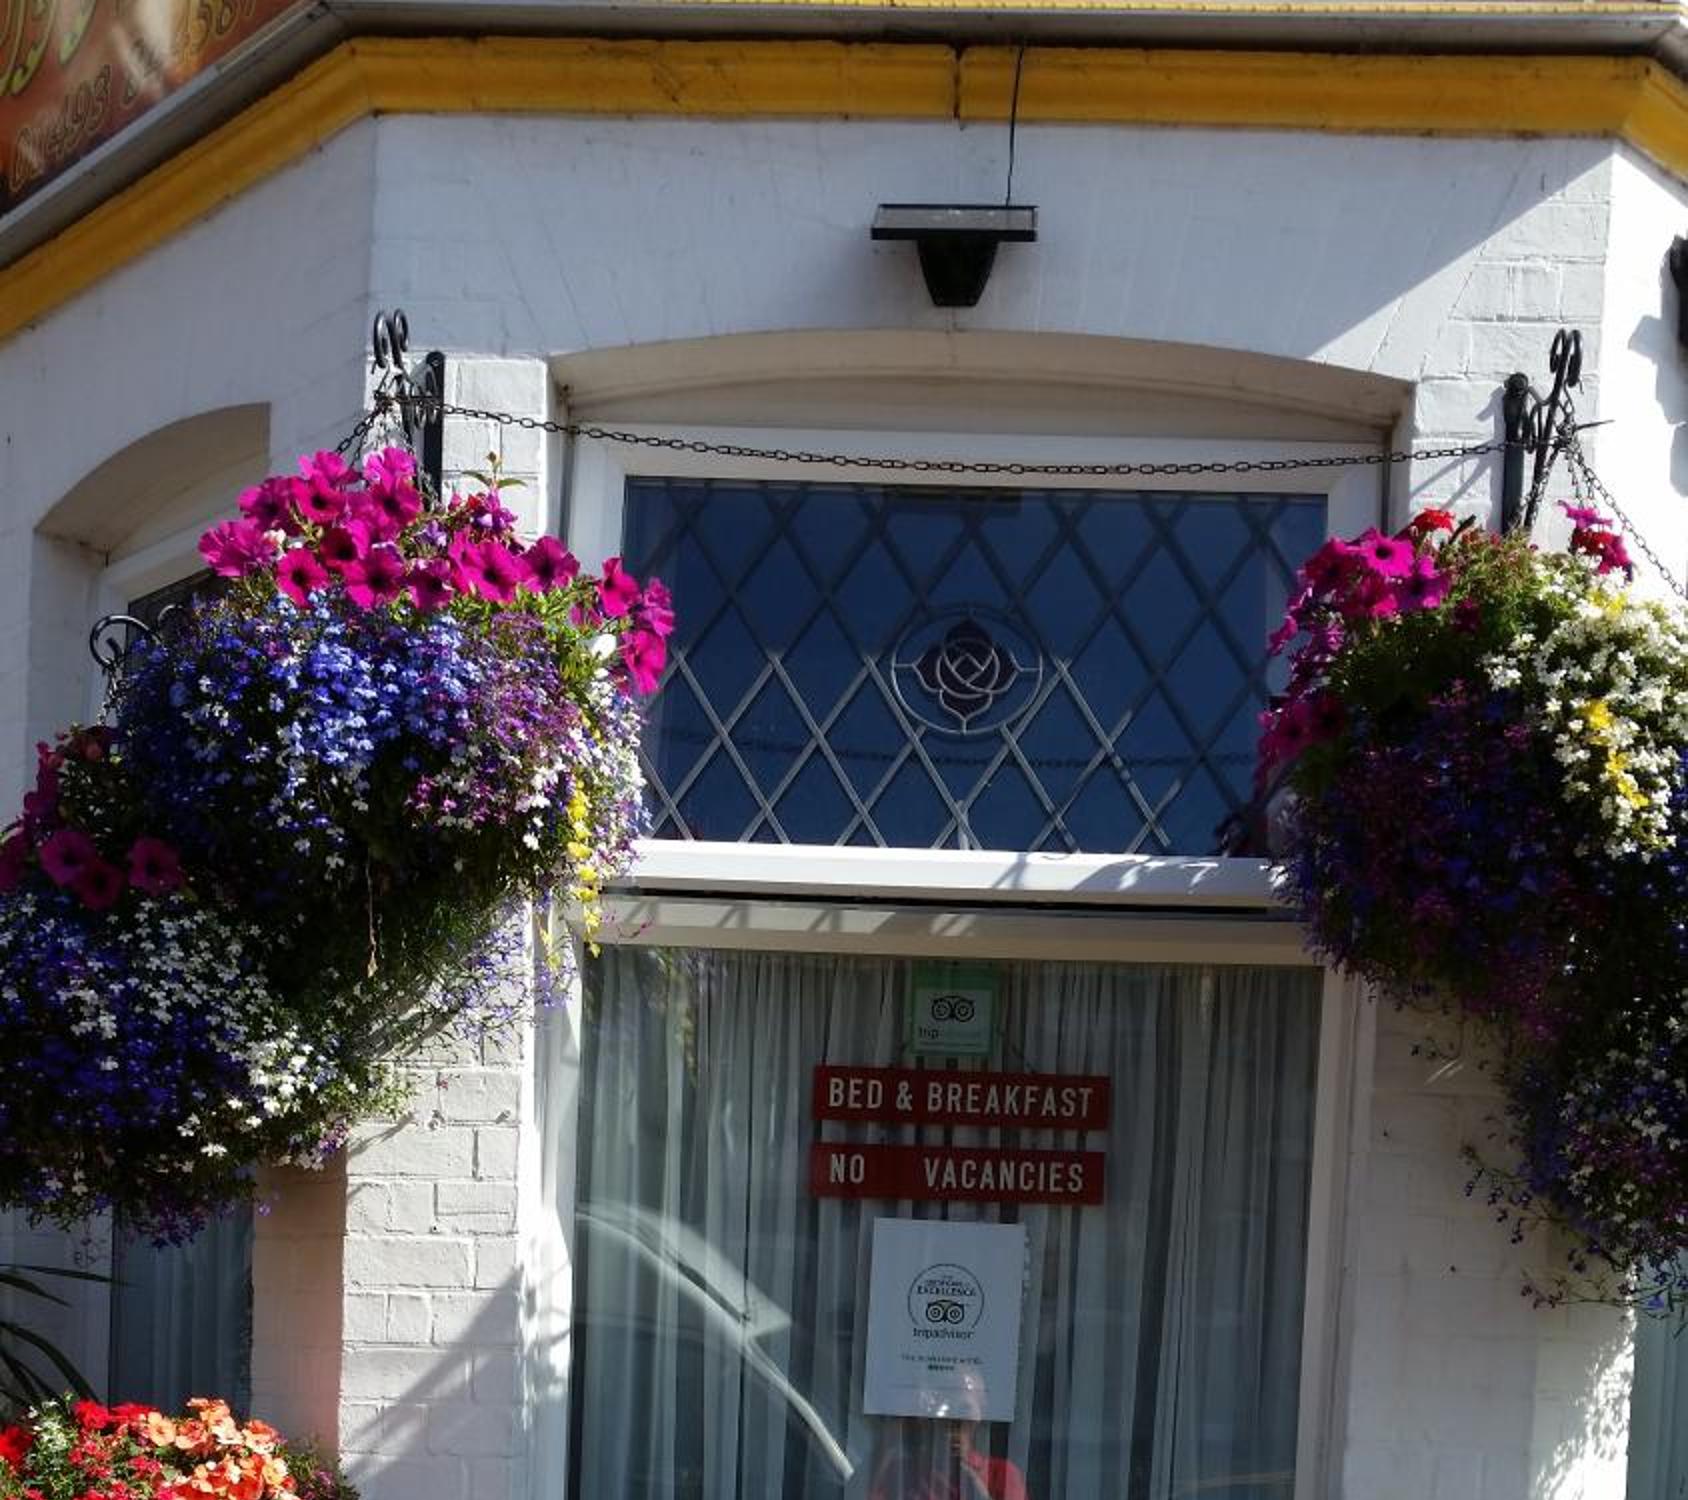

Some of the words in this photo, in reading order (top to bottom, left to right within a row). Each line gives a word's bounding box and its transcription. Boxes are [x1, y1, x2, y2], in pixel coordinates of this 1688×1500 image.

[828, 1077, 883, 1110] BED
[895, 1080, 913, 1111] &
[927, 1081, 1094, 1118] BREAKFAST
[829, 1153, 866, 1184] NO
[923, 1157, 1085, 1193] VACANCIES
